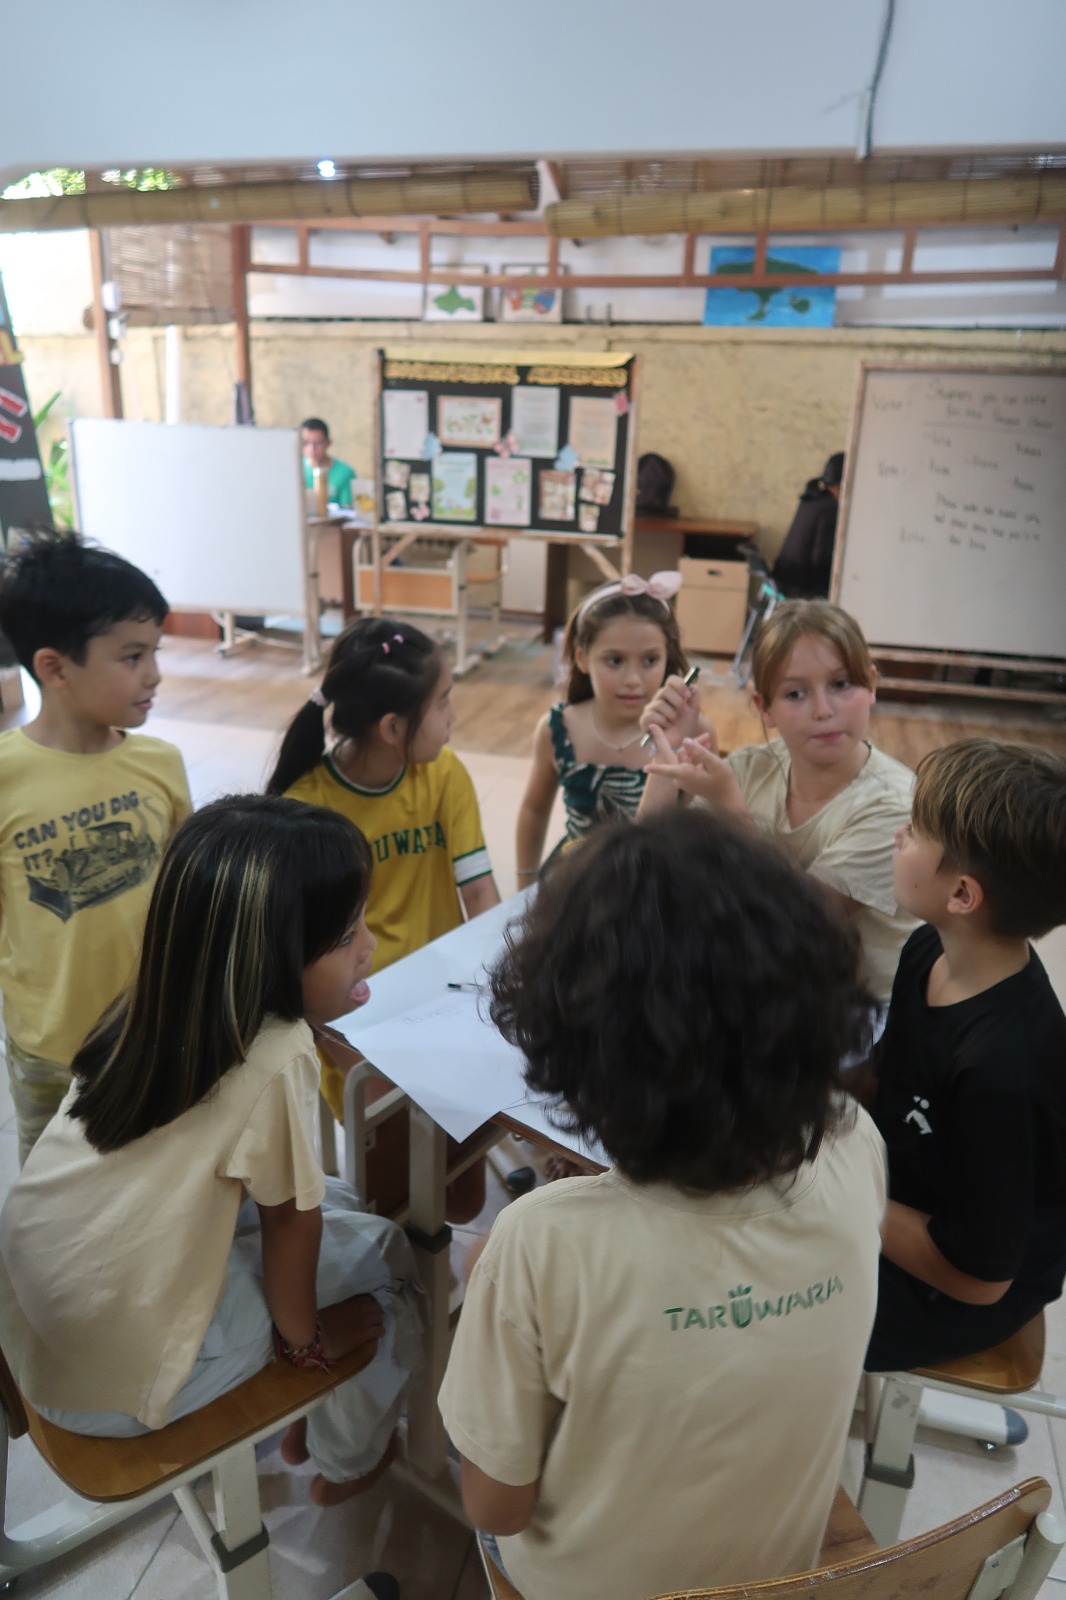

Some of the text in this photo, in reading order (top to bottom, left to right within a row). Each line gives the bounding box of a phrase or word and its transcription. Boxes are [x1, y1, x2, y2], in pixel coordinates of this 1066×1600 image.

[13, 790, 140, 850] CAN YOU DIG
[23, 849, 54, 872] IT?
[663, 1274, 844, 1332] TARUWARA
